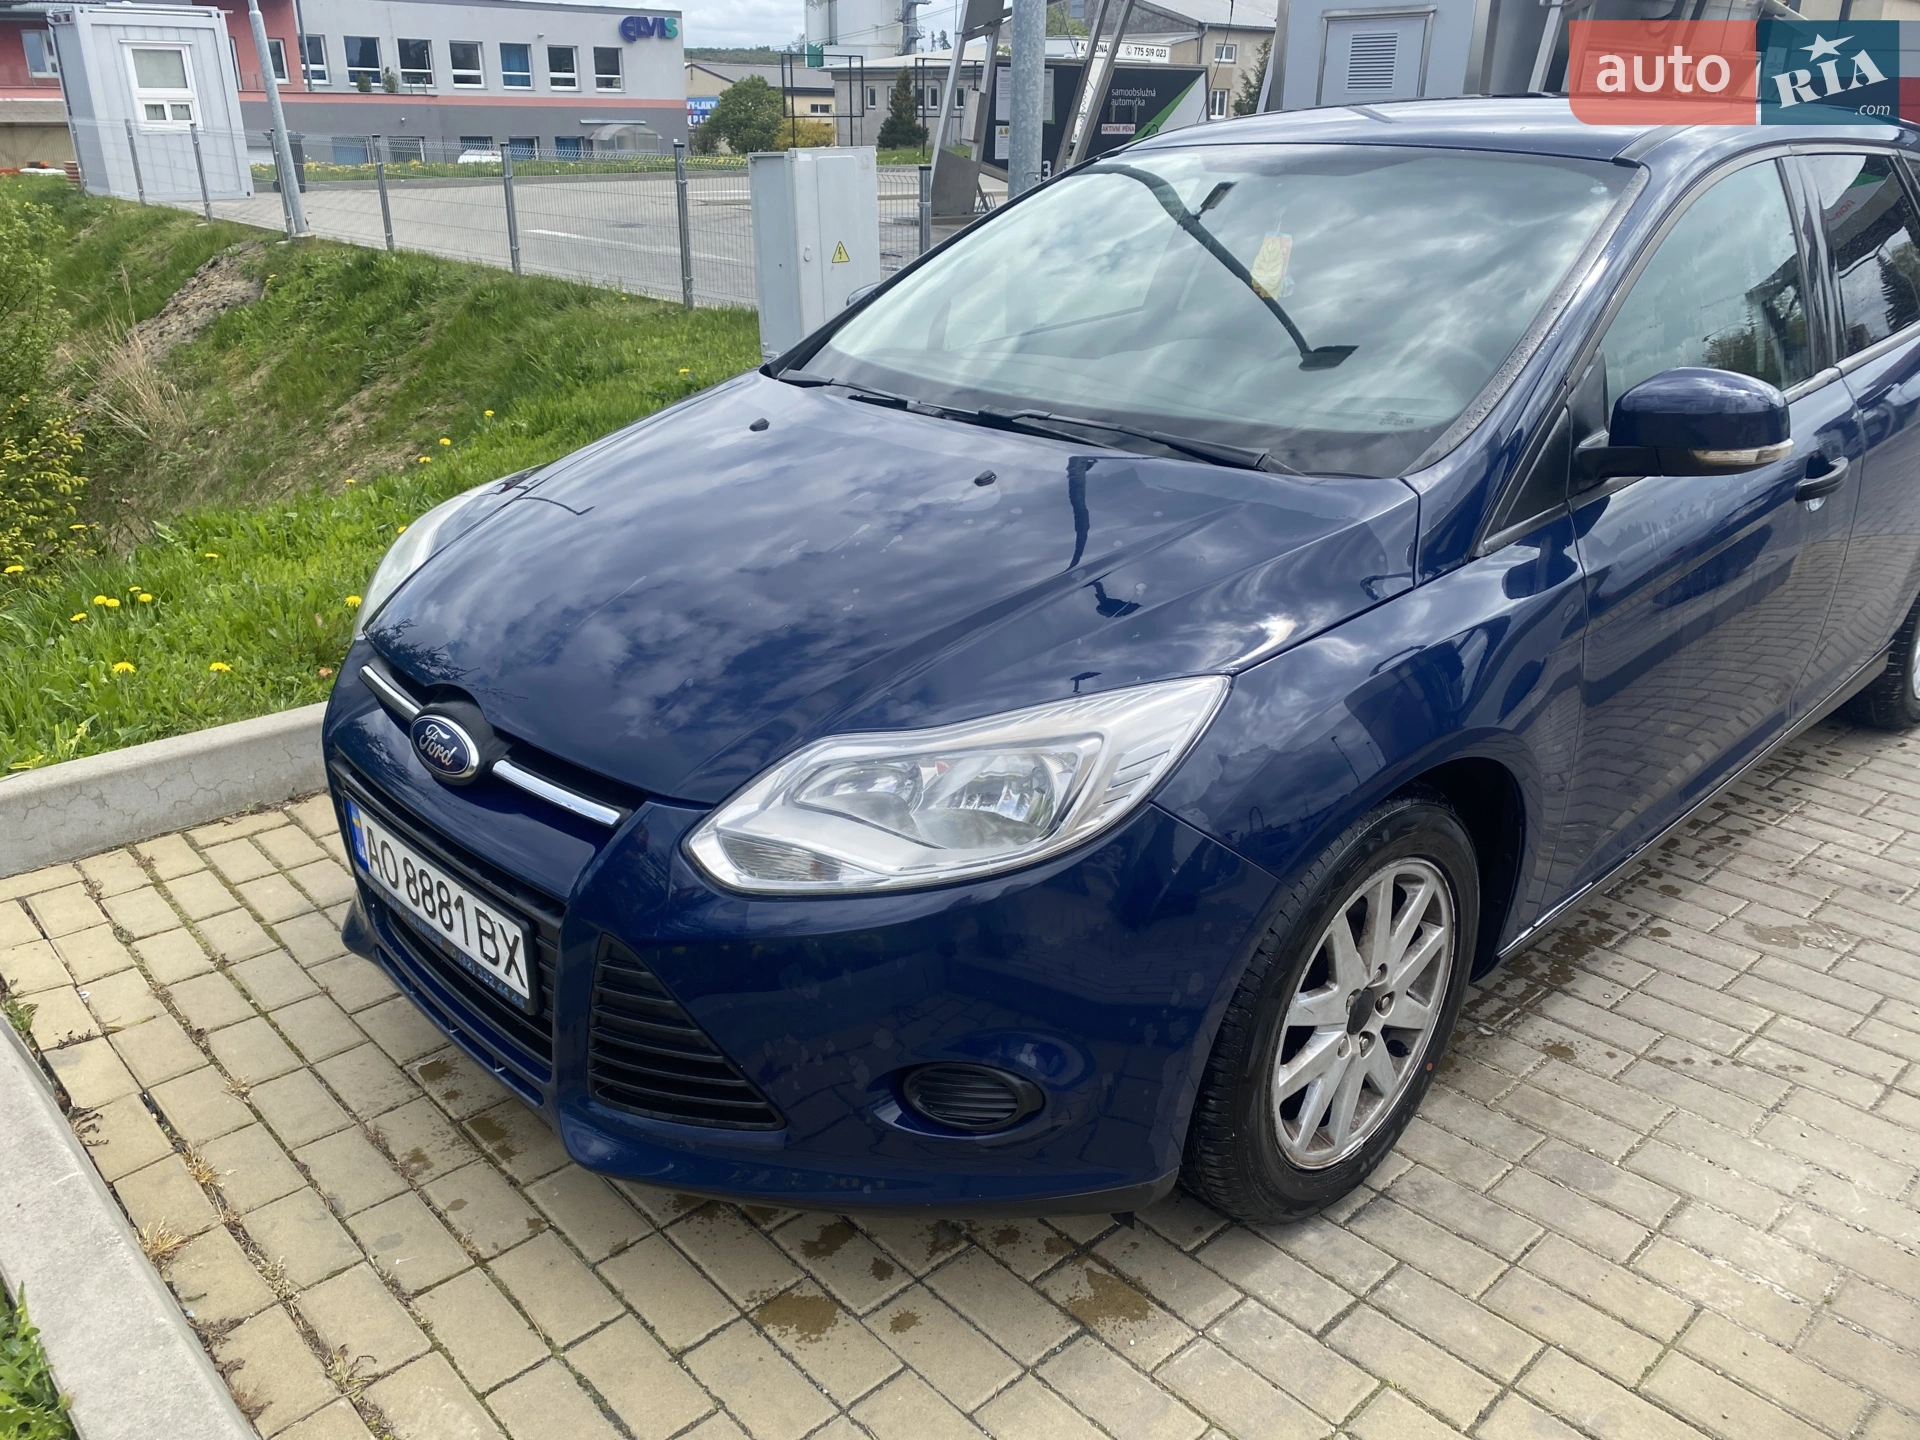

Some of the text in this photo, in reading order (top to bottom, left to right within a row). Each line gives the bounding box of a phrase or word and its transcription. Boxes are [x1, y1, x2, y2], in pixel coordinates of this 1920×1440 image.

[620, 16, 679, 42] ELVIS
[1133, 46, 1144, 56] 775
[1111, 87, 1157, 97] samoobslužná
[1042, 160, 1051, 180] 3
[419, 724, 458, 766] Ford
[366, 825, 528, 990] AO 8881 BX
